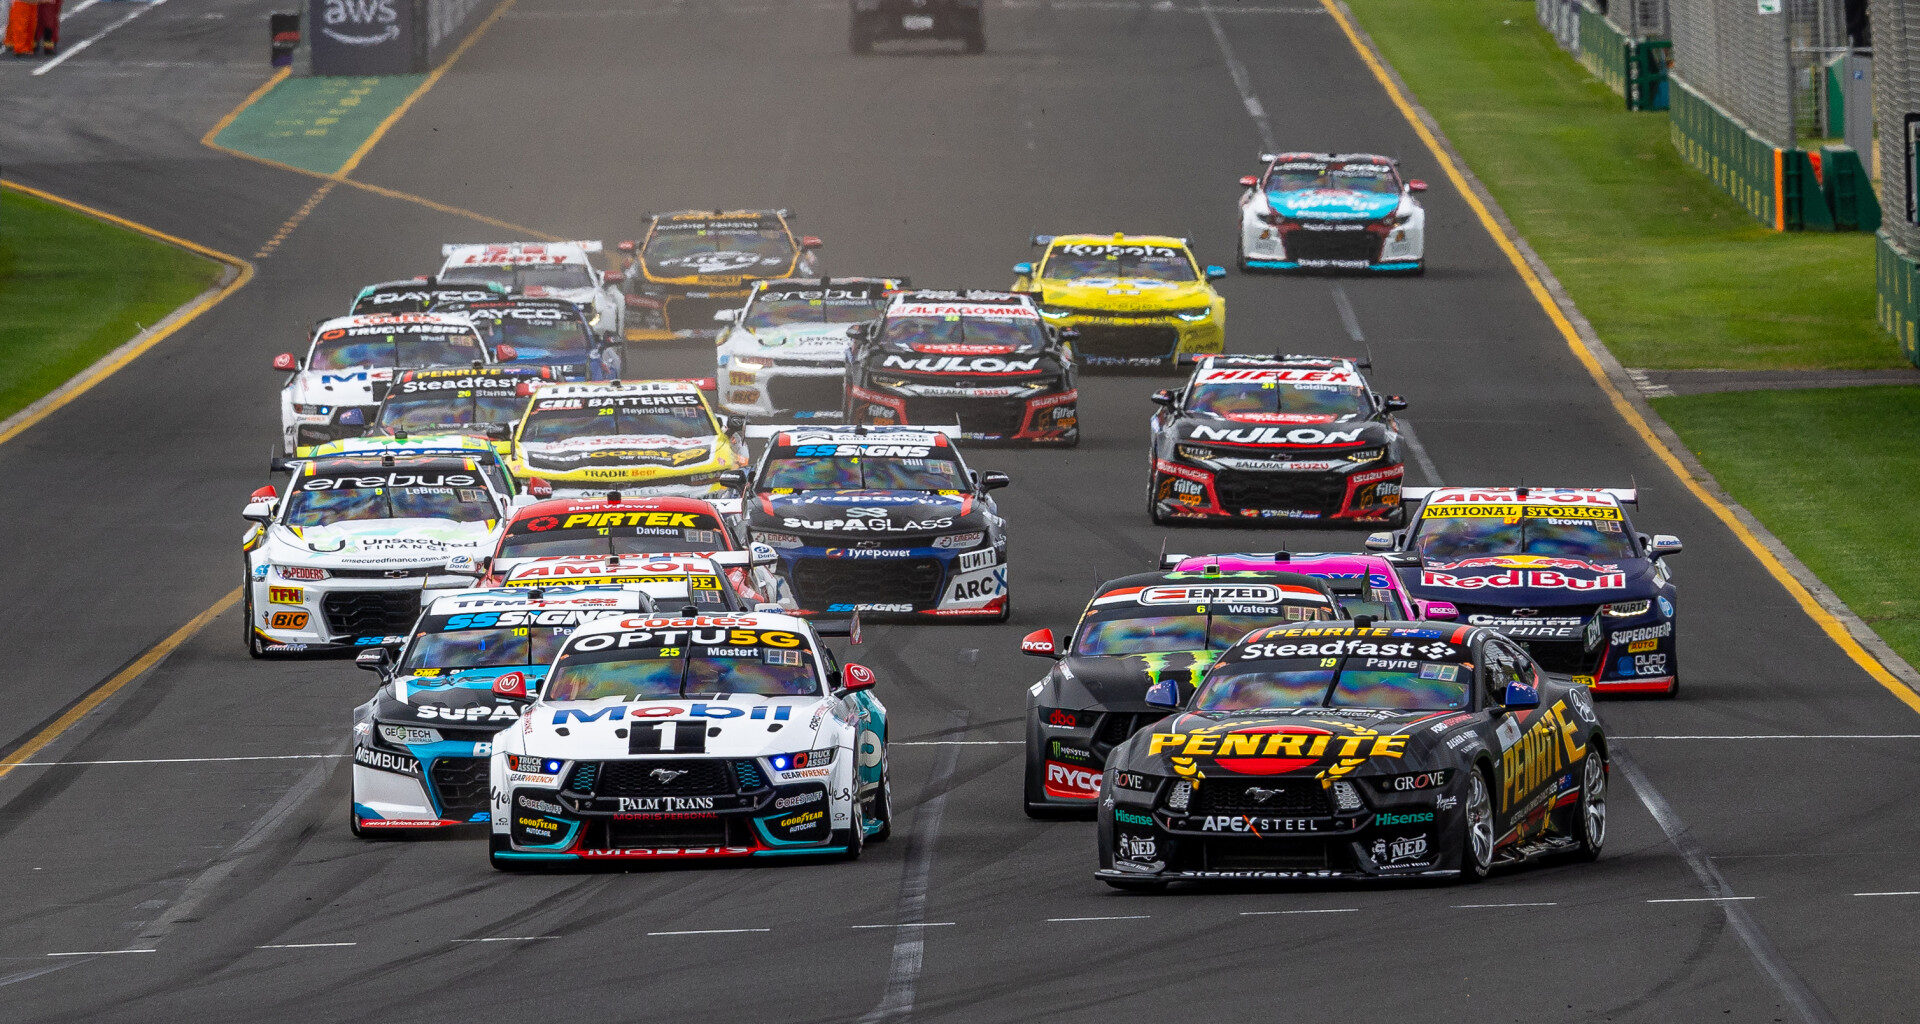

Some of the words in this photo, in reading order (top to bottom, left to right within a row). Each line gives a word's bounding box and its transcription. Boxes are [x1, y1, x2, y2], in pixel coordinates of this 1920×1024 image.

[323, 0, 398, 24] aws
[468, 309, 563, 320] AYCO
[883, 355, 1040, 372] NULON
[417, 368, 502, 379] PENRITE
[1205, 371, 1352, 382] HIFLEX
[403, 377, 518, 393] Steadfast
[1261, 382, 1275, 390] 31
[1294, 384, 1338, 392] Golding
[475, 389, 516, 397] Stanaw
[588, 395, 698, 407] BATTERIES
[598, 408, 614, 416] 20
[622, 407, 672, 416] Reynolds
[1190, 425, 1364, 444] NULON
[902, 458, 923, 466] Hill
[584, 469, 629, 478] TRADIE
[303, 473, 476, 491] erebus
[405, 487, 454, 496] LeBrocq
[1435, 493, 1612, 506] AMPOL
[568, 504, 599, 512] Shell
[604, 503, 660, 511] V-Power
[1426, 506, 1517, 517] NATIONAL
[1527, 507, 1618, 519] STORAGE
[562, 512, 701, 528] PIRTEK
[1547, 517, 1593, 527] Brown
[636, 527, 679, 536] Davison
[848, 548, 911, 559] Tyrepower
[291, 567, 324, 580] PEDDERS
[516, 562, 711, 579] AMPOL
[1421, 569, 1524, 589] Red
[1529, 570, 1627, 591] Bull
[271, 588, 299, 602] TFH
[1188, 588, 1268, 599] ENZED
[1196, 605, 1206, 614] 6
[1228, 604, 1279, 614] Waters
[620, 616, 759, 629] Coates
[511, 627, 528, 637] 10
[1265, 627, 1392, 639] PENRITE
[1508, 627, 1573, 636] HIRE
[1611, 621, 1672, 646] SUPERCHEAP
[1021, 641, 1053, 651] RYCO
[1241, 639, 1411, 660] Steadfast
[1631, 640, 1655, 650] AUTO
[659, 648, 680, 657] 25
[707, 647, 759, 657] Mostert
[1319, 657, 1337, 668] 19
[1365, 658, 1419, 671] Payne
[1635, 653, 1667, 665] QUAD
[1635, 664, 1667, 676] LOCK
[552, 703, 792, 725] Mobil
[652, 721, 679, 751] 1
[1147, 732, 1410, 759] PENRITE
[808, 749, 831, 760] TRUCK
[518, 756, 541, 766] TRUCK
[805, 758, 830, 769] ASSIST
[517, 764, 541, 773] ASSIST
[781, 768, 830, 780] GEARWRENCH
[510, 773, 555, 784] GEARWRENCH
[1394, 771, 1445, 791] GROVE
[618, 797, 660, 812] PALM
[662, 796, 714, 812] TRANS
[613, 812, 662, 820] MORRIS
[780, 811, 823, 827] GOODYEAR
[1115, 809, 1154, 826] Hisense
[1375, 812, 1434, 827] Hisense
[518, 817, 558, 831] GOODYEAR
[789, 821, 818, 834] AUTOCARE
[1202, 815, 1262, 837] APEX
[1260, 819, 1318, 831] STEEL
[1131, 841, 1156, 856] NED
[1392, 838, 1428, 858] NED
